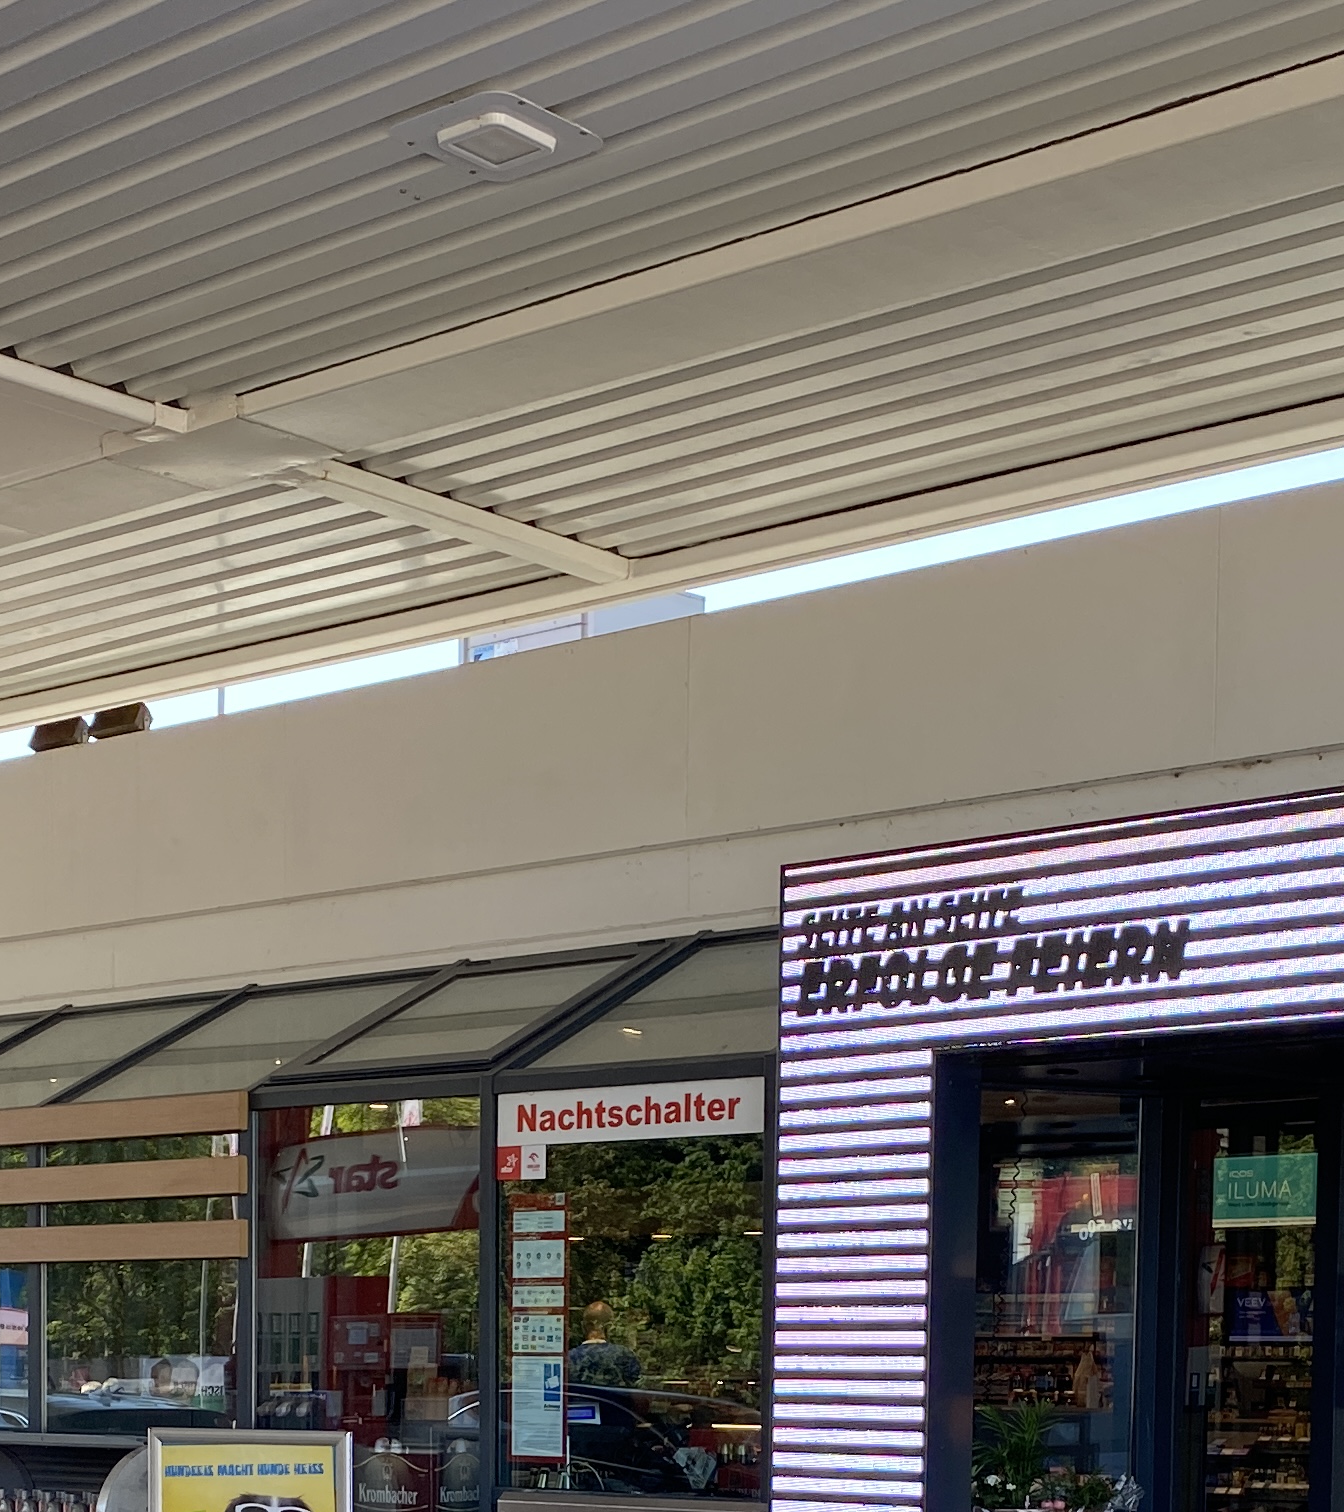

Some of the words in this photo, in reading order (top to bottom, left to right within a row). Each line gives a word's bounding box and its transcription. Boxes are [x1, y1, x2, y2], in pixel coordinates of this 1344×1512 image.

[517, 1092, 741, 1132] Nachtschalter
[1228, 1180, 1292, 1199] ILUMA
[1237, 1297, 1266, 1308] VEEV
[217, 1464, 254, 1476] MACHT
[257, 1464, 290, 1475] HUNDE
[293, 1463, 324, 1475] HEISS
[359, 1483, 418, 1505] Krombacher
